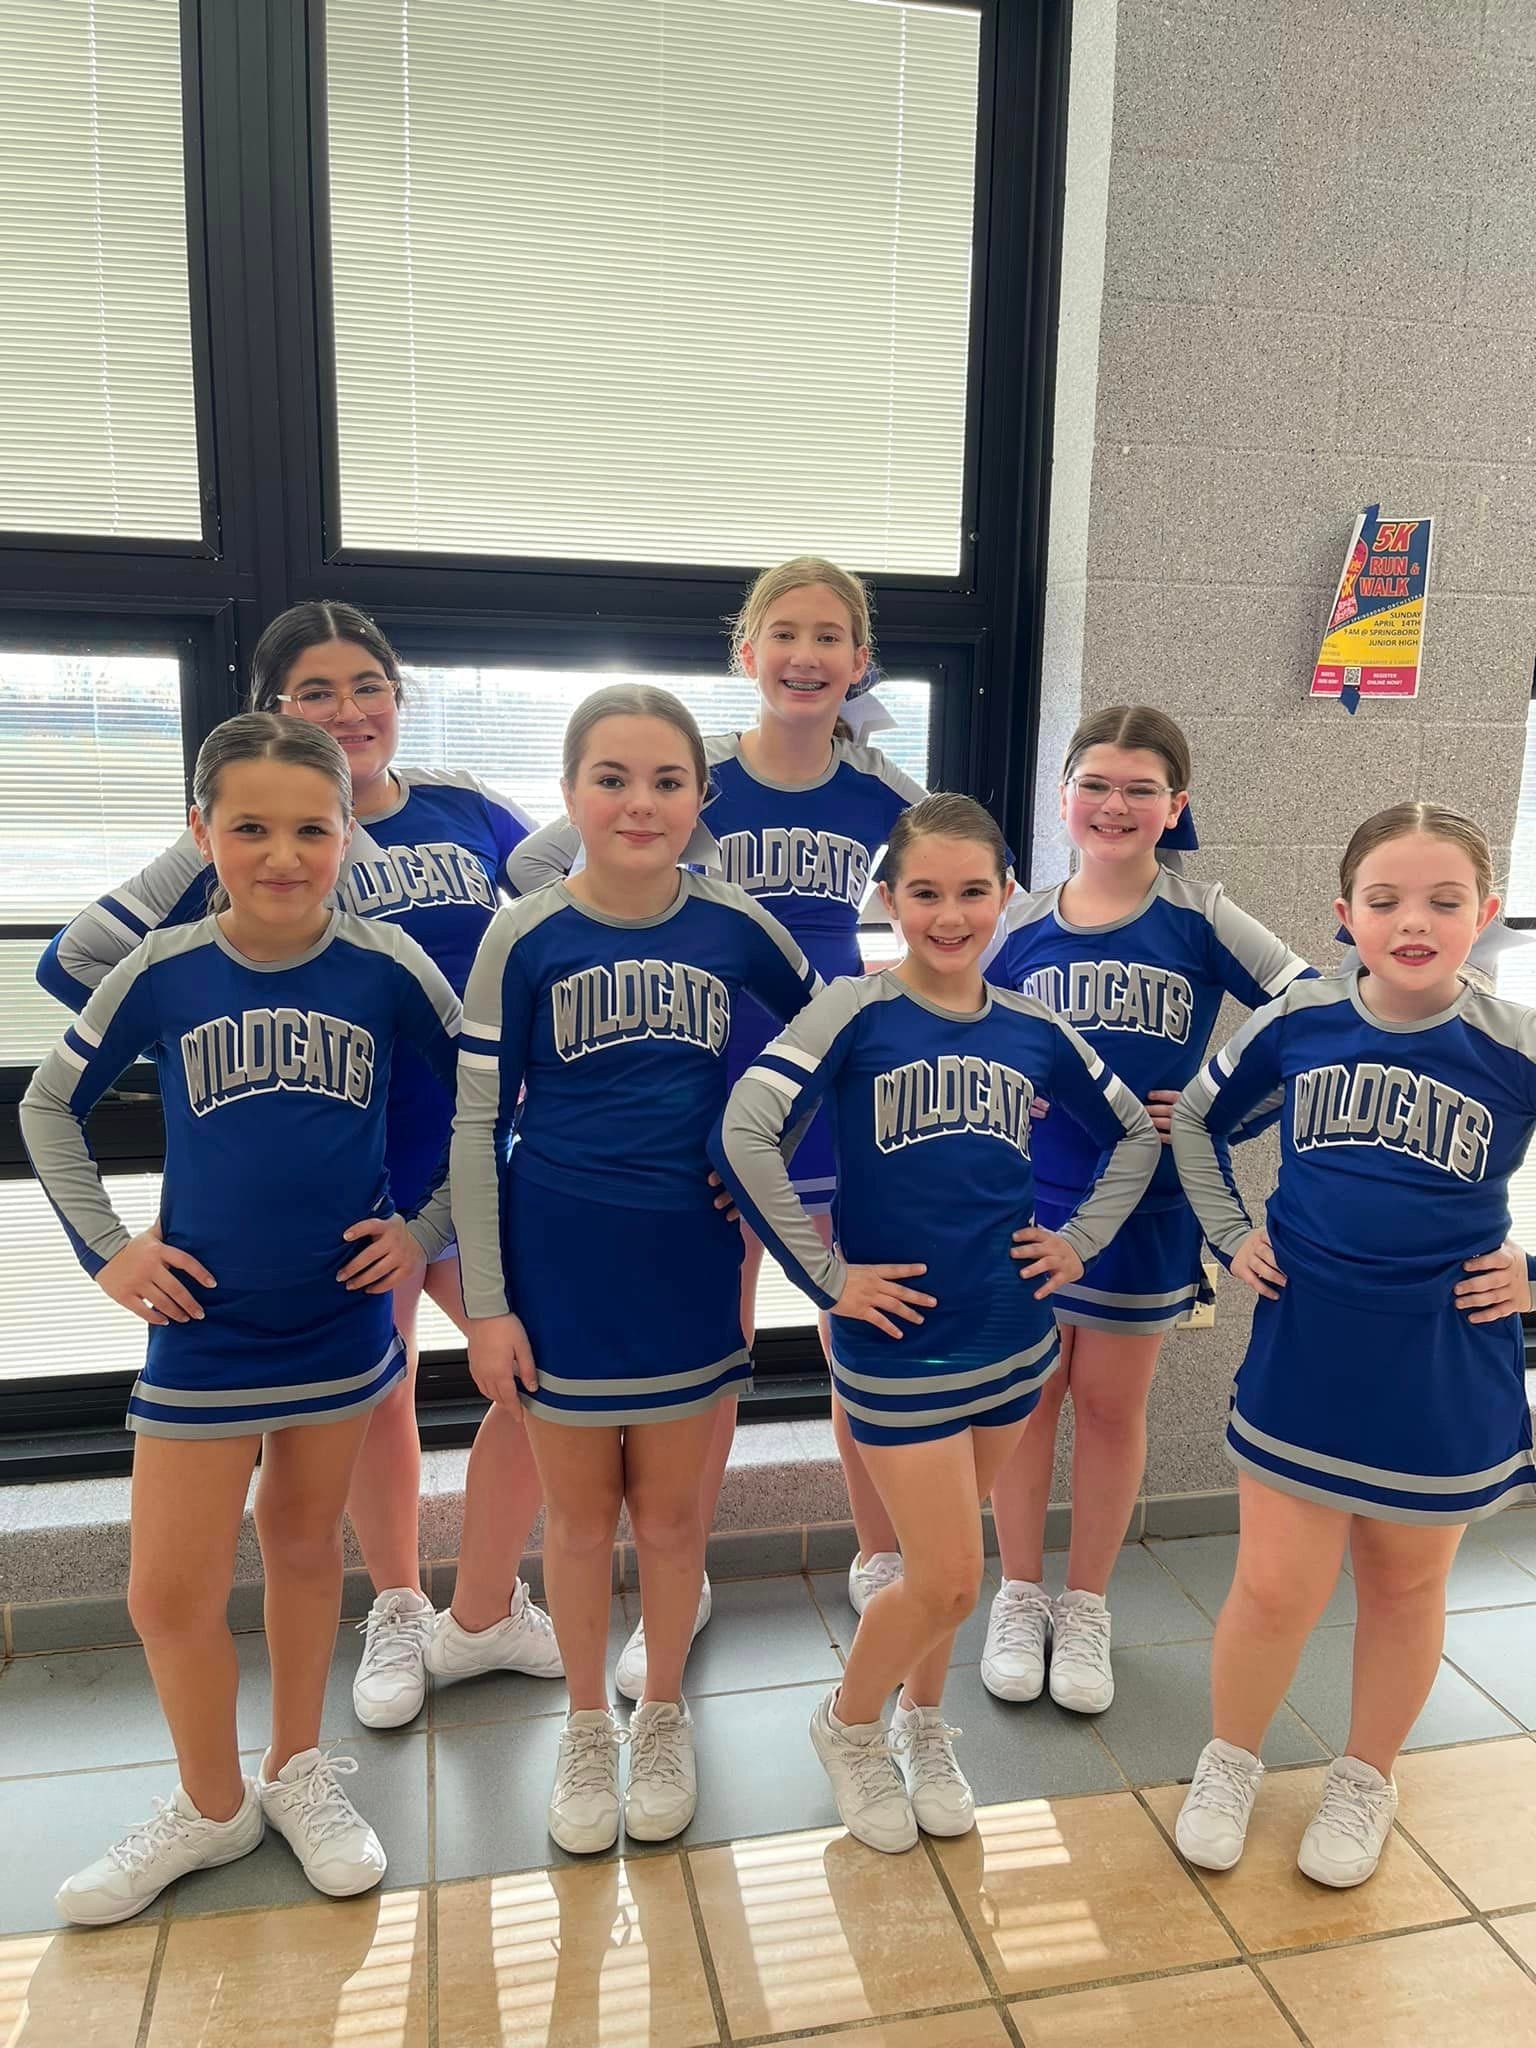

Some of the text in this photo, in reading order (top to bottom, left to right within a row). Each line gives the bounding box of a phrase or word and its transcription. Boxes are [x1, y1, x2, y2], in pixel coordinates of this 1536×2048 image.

[1369, 556, 1408, 576] RUN
[1410, 563, 1420, 575] &
[1372, 522, 1419, 551] 5K
[1360, 577, 1409, 597] WALK
[552, 959, 730, 1062] WILDCATS
[181, 1008, 375, 1117] WILDCATS
[1294, 1063, 1493, 1183] WILDCATS
